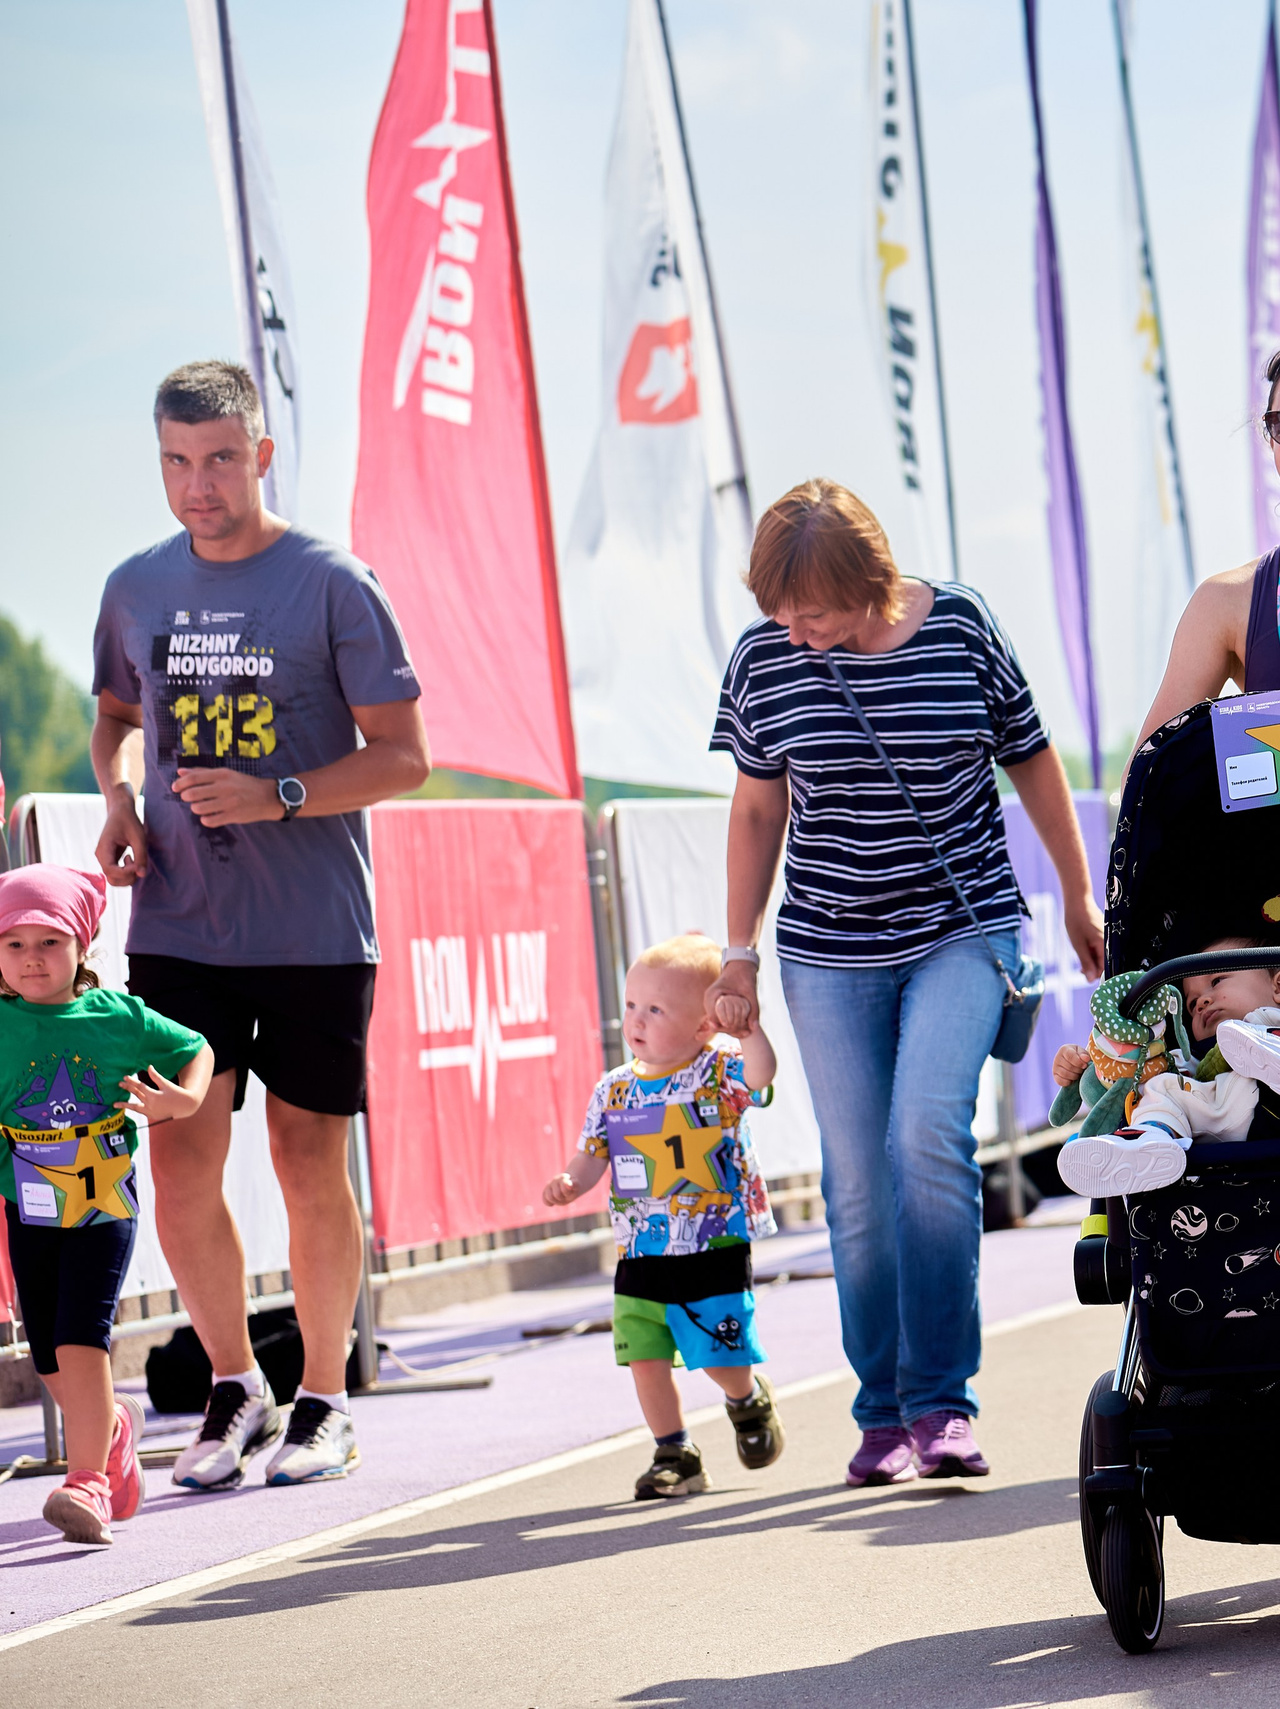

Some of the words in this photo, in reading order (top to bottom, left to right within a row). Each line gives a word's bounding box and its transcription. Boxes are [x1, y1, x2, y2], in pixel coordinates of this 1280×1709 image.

[169, 633, 240, 654] NIZHNY
[167, 655, 274, 677] NOVGOROD
[169, 693, 276, 758] 113
[410, 935, 473, 1034] IRON
[491, 929, 549, 1026] LADY
[664, 1135, 685, 1170] 1
[77, 1166, 95, 1200] 1
